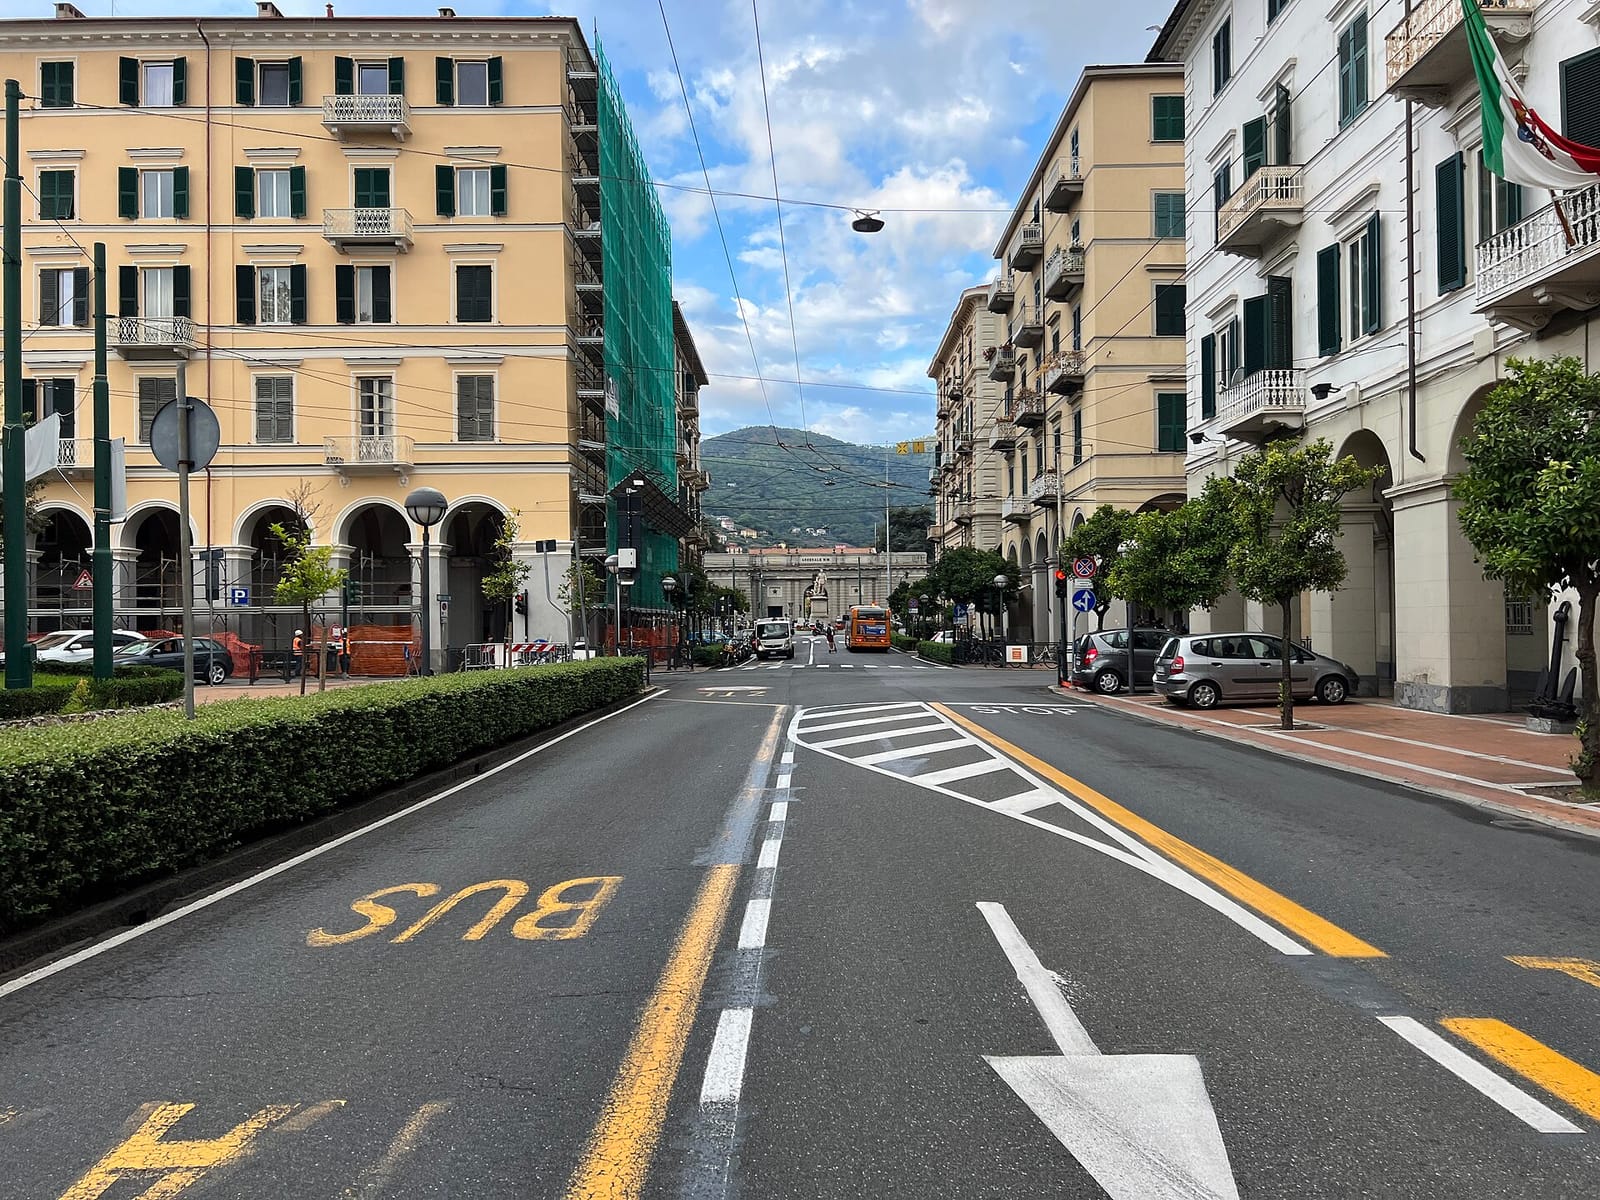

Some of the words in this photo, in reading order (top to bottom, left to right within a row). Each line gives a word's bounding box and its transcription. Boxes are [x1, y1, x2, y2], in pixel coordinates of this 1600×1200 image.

[235, 590, 245, 603] P
[969, 705, 1078, 716] STOP
[306, 875, 625, 947] BUS
